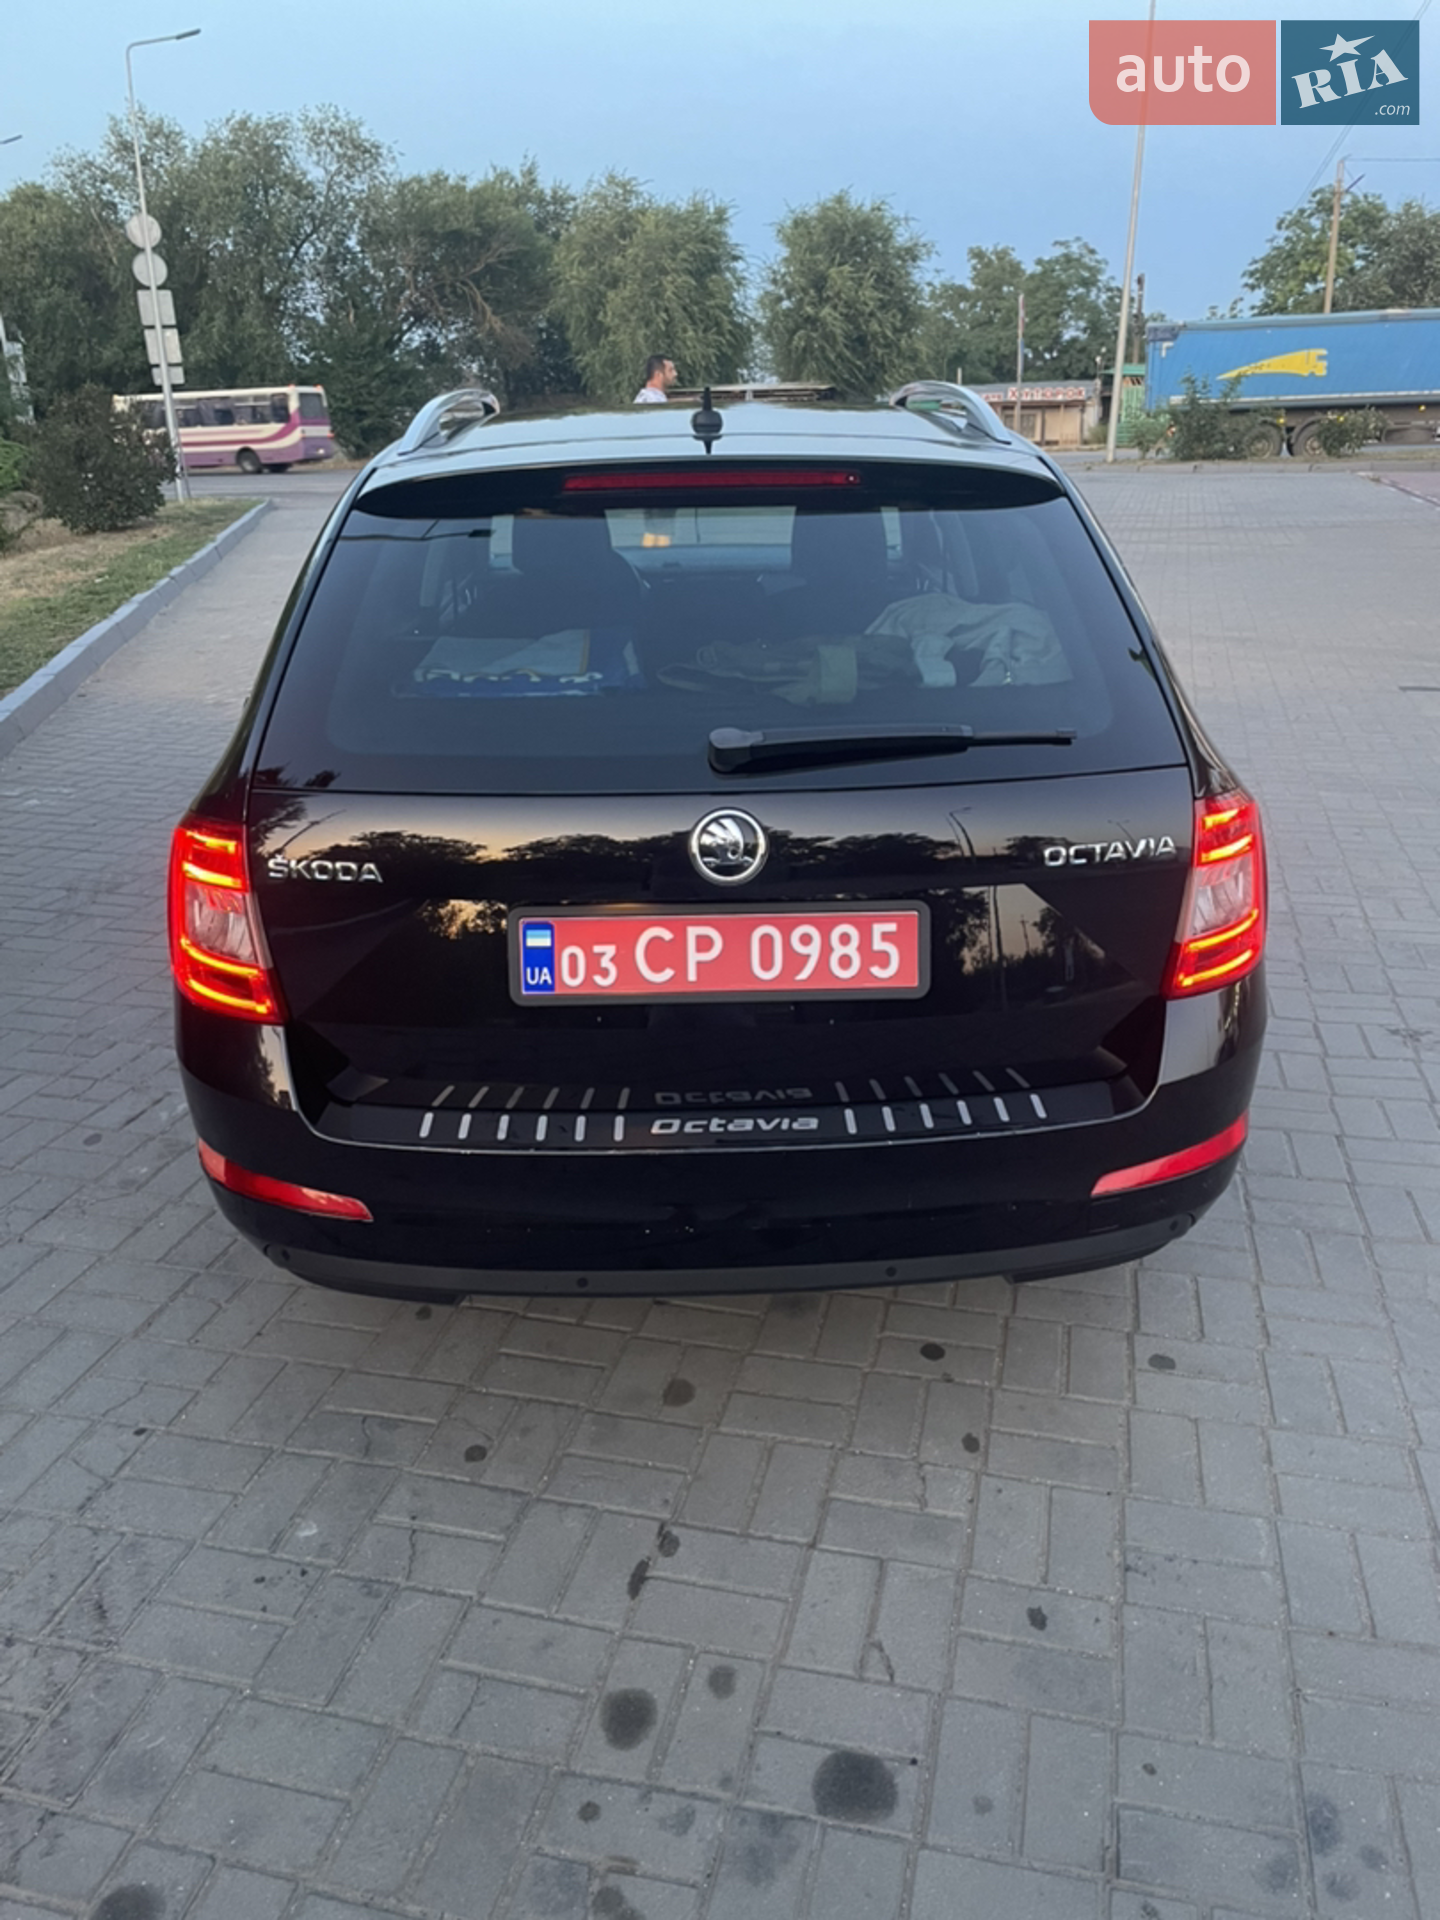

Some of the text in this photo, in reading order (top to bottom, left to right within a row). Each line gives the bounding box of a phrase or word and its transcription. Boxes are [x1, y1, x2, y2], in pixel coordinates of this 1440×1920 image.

[1043, 836, 1177, 867] OCTAVIA
[267, 854, 384, 883] ŠKODA
[560, 922, 900, 987] 03 CP 0985
[526, 966, 552, 985] UA
[650, 1116, 819, 1135] Octavia
